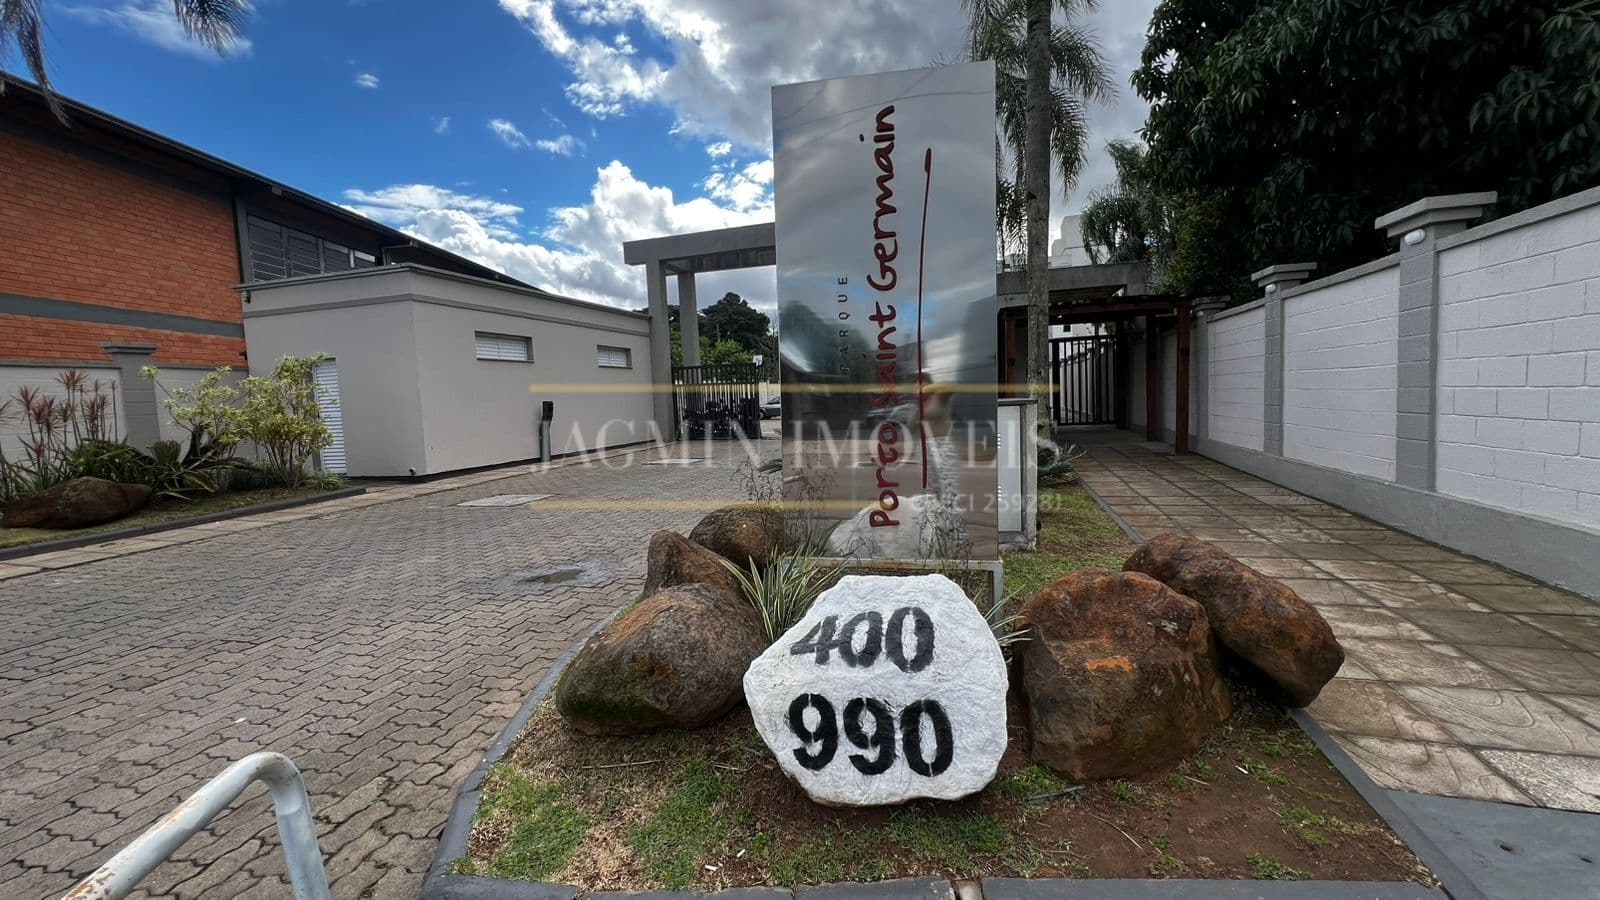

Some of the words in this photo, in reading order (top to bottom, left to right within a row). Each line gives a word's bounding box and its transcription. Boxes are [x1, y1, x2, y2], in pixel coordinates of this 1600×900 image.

[859, 104, 898, 291] Germain
[837, 275, 850, 374] PARQUE
[861, 301, 898, 408] Saint
[869, 421, 899, 528] Porto
[790, 606, 935, 673] 400
[786, 692, 954, 778] 990
